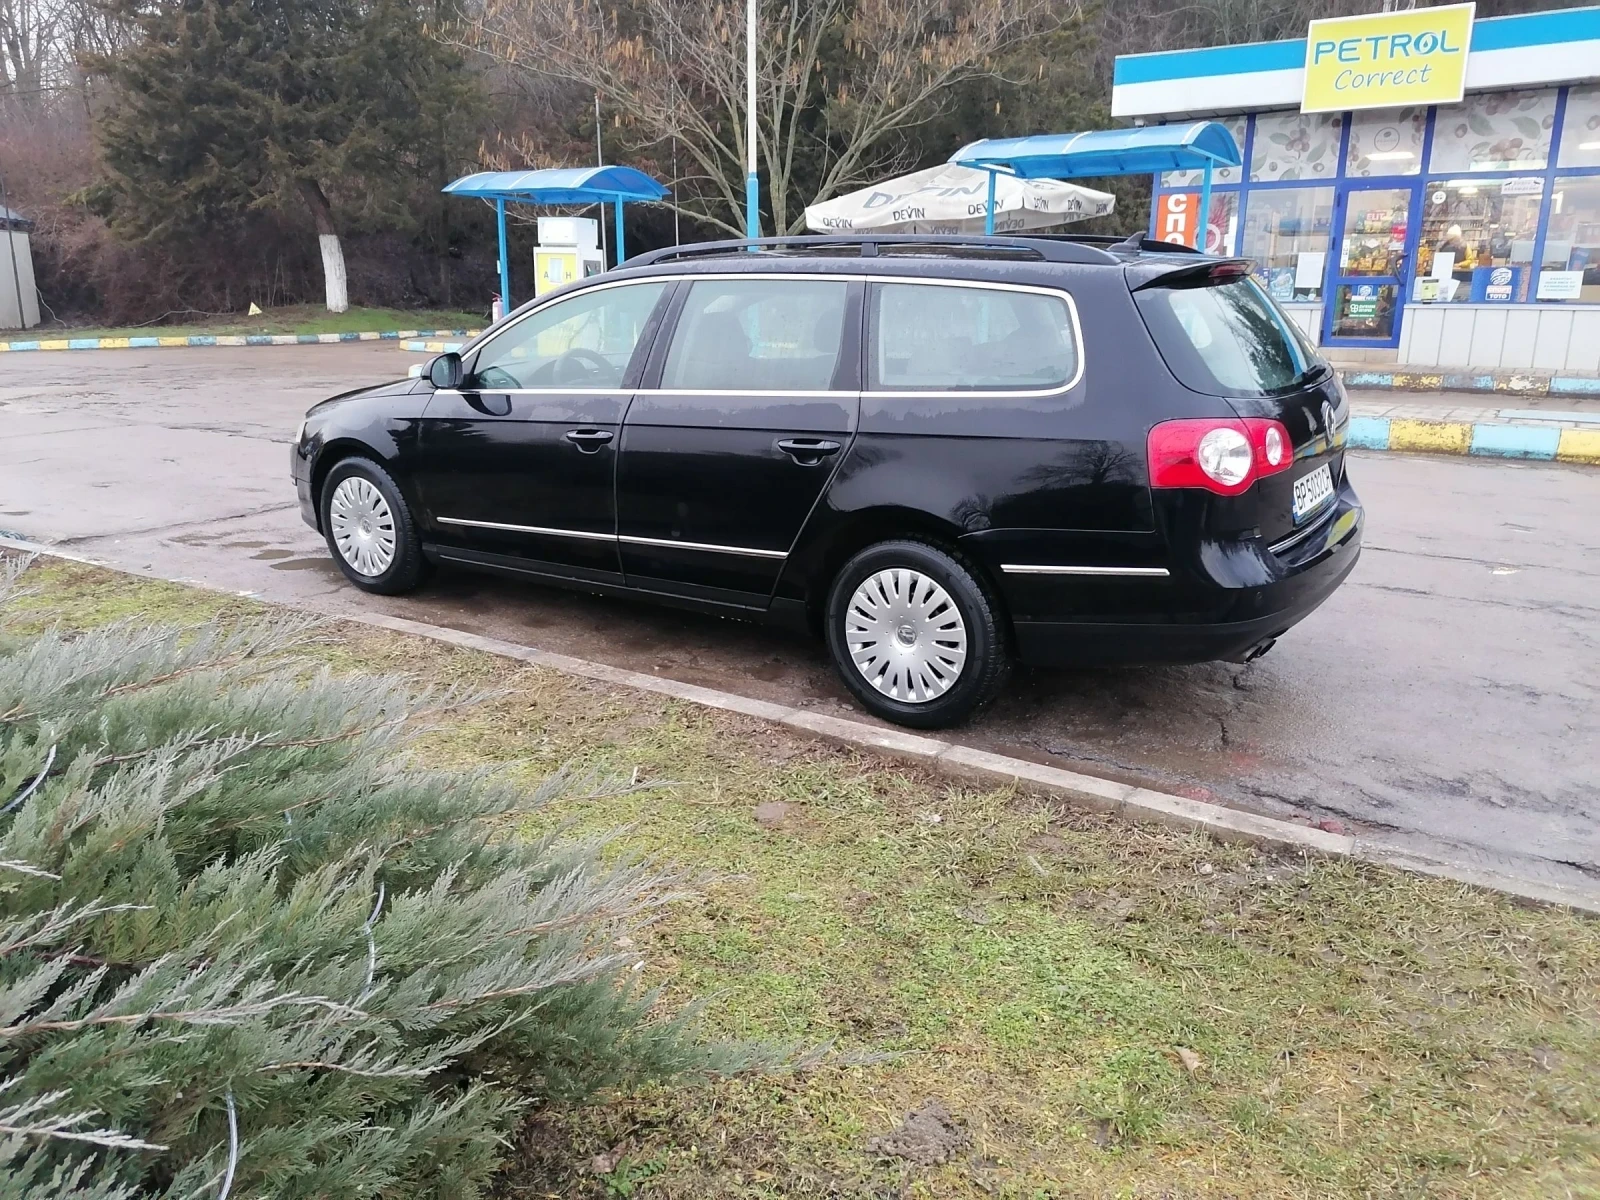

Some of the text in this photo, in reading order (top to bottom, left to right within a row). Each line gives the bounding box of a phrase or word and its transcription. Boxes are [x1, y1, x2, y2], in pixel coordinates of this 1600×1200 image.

[1314, 30, 1459, 65] PETROL
[1335, 64, 1432, 90] Correct
[893, 206, 925, 221] DEVIN
[968, 200, 1004, 215] DEVN
[823, 217, 852, 228] DEVIN
